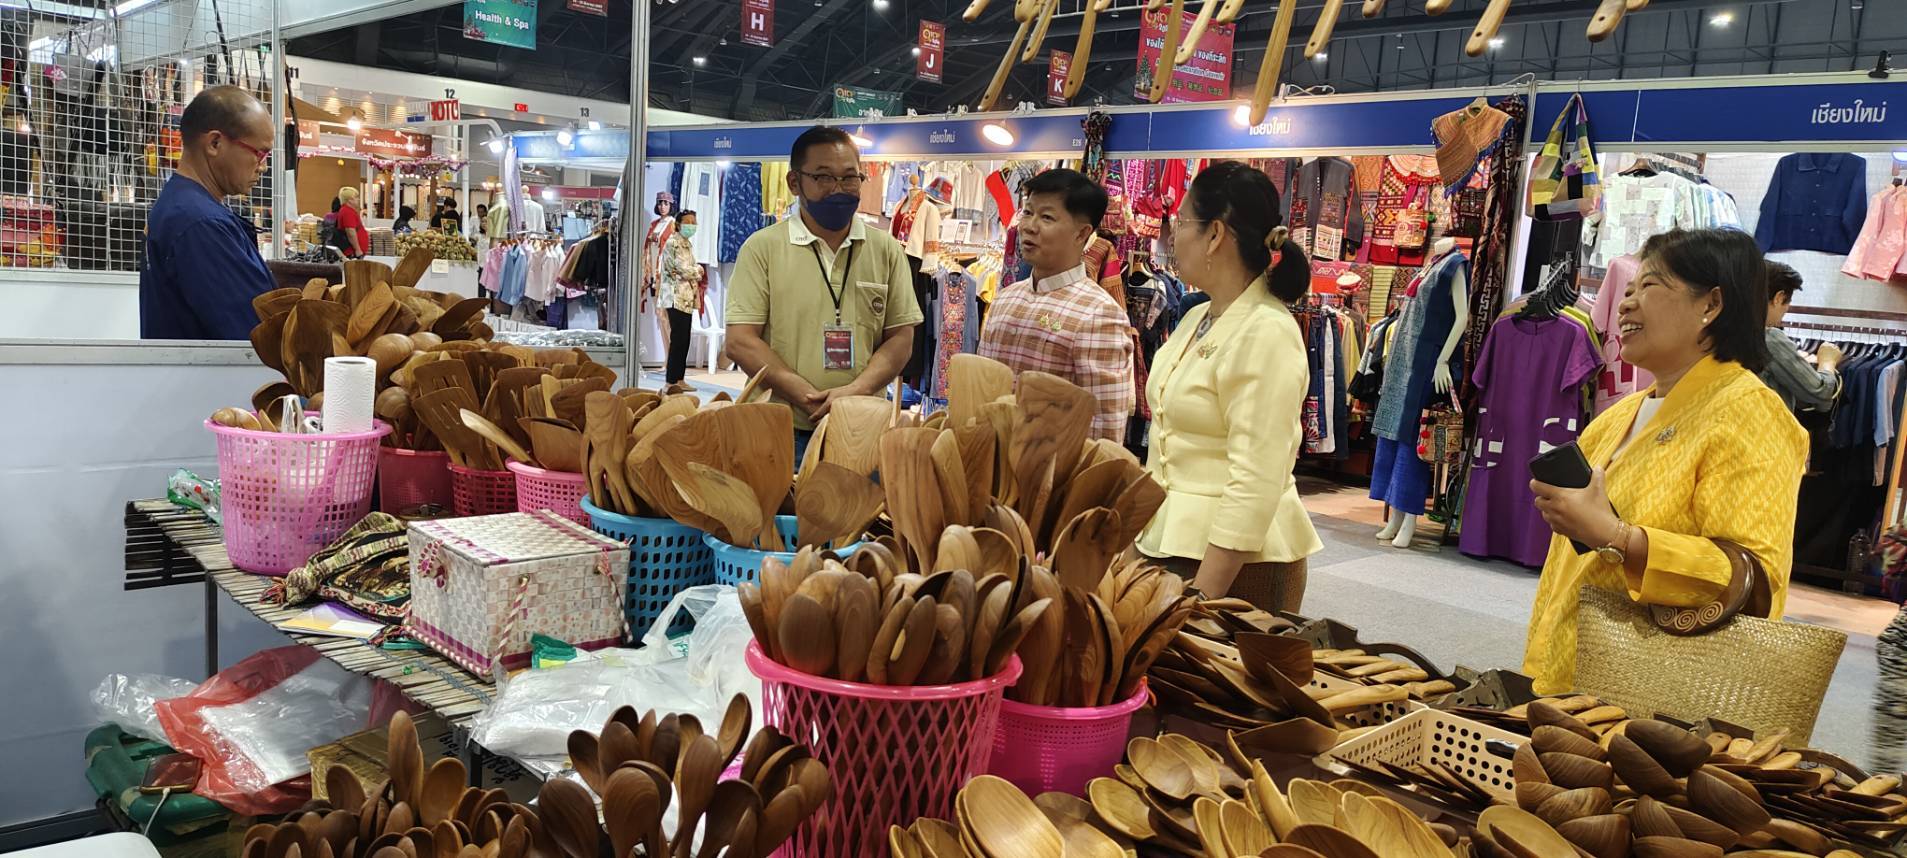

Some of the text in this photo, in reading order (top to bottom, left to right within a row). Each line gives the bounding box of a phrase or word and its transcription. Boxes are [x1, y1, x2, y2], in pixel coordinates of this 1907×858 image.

[475, 10, 529, 30] Health & Spa
[751, 12, 764, 31] H
[925, 53, 935, 69] J
[444, 88, 456, 99] 12
[1054, 79, 1064, 94] K
[580, 107, 590, 118] 13
[1811, 98, 1887, 124] เชียงใหม่
[1249, 116, 1291, 136] เชยงใหม่
[929, 128, 956, 144] เชียงใหม่
